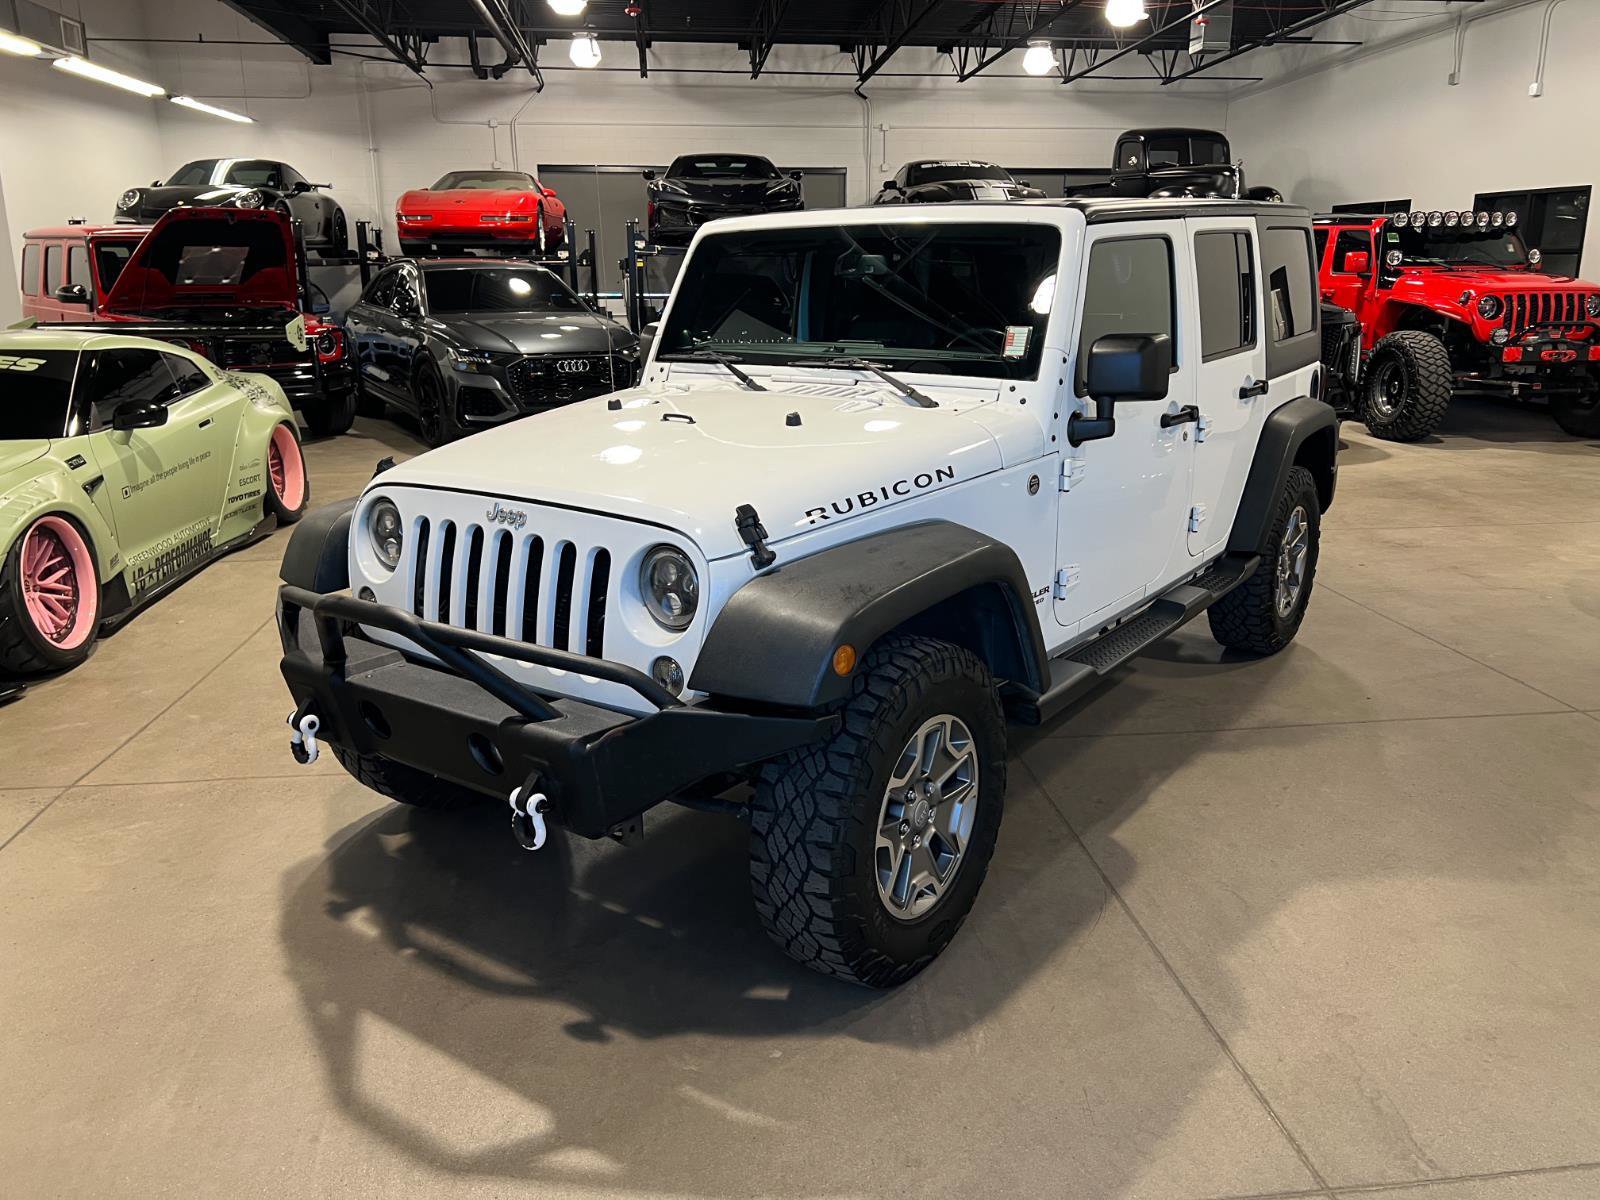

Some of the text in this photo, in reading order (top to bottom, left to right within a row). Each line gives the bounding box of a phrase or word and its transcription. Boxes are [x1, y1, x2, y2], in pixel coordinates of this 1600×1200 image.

[228, 493, 244, 504] TOYO
[805, 465, 955, 524] RUBICON
[486, 502, 528, 530] Jeep
[128, 537, 173, 566] GREENWOOD
[173, 516, 211, 541] AUTOMOTIVE
